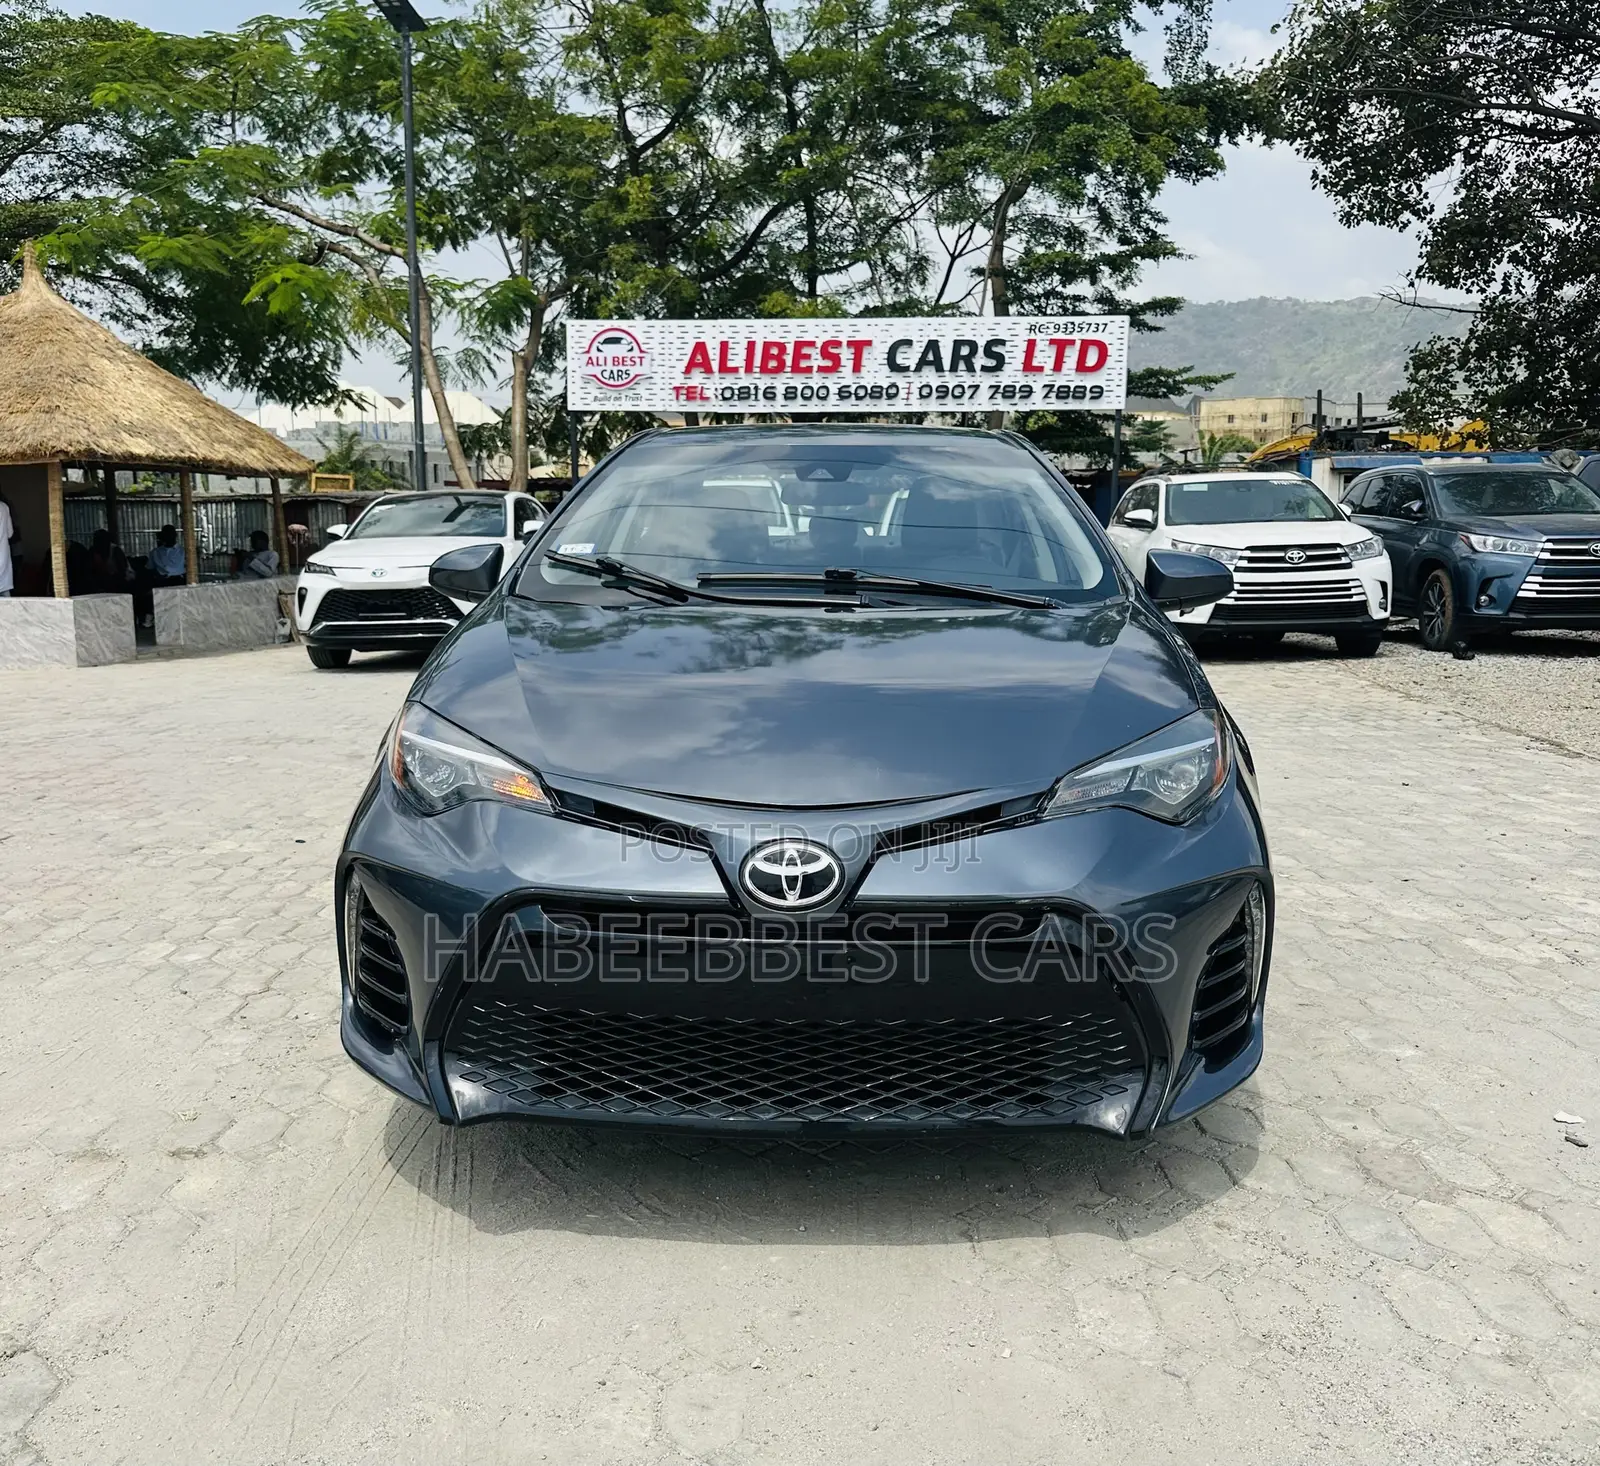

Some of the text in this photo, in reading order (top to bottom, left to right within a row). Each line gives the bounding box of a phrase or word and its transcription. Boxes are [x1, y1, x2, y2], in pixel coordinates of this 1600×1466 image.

[1053, 321, 1108, 334] 9335737
[585, 356, 645, 367] ALI BEST
[684, 338, 1108, 375] ALIBEST CARS LTD
[600, 368, 631, 381] CARS
[720, 385, 777, 401] 0816
[783, 385, 830, 401] 800
[838, 384, 900, 401] 6080
[918, 383, 980, 400] 0907
[988, 383, 1034, 400] 789
[1042, 383, 1104, 400] 7889
